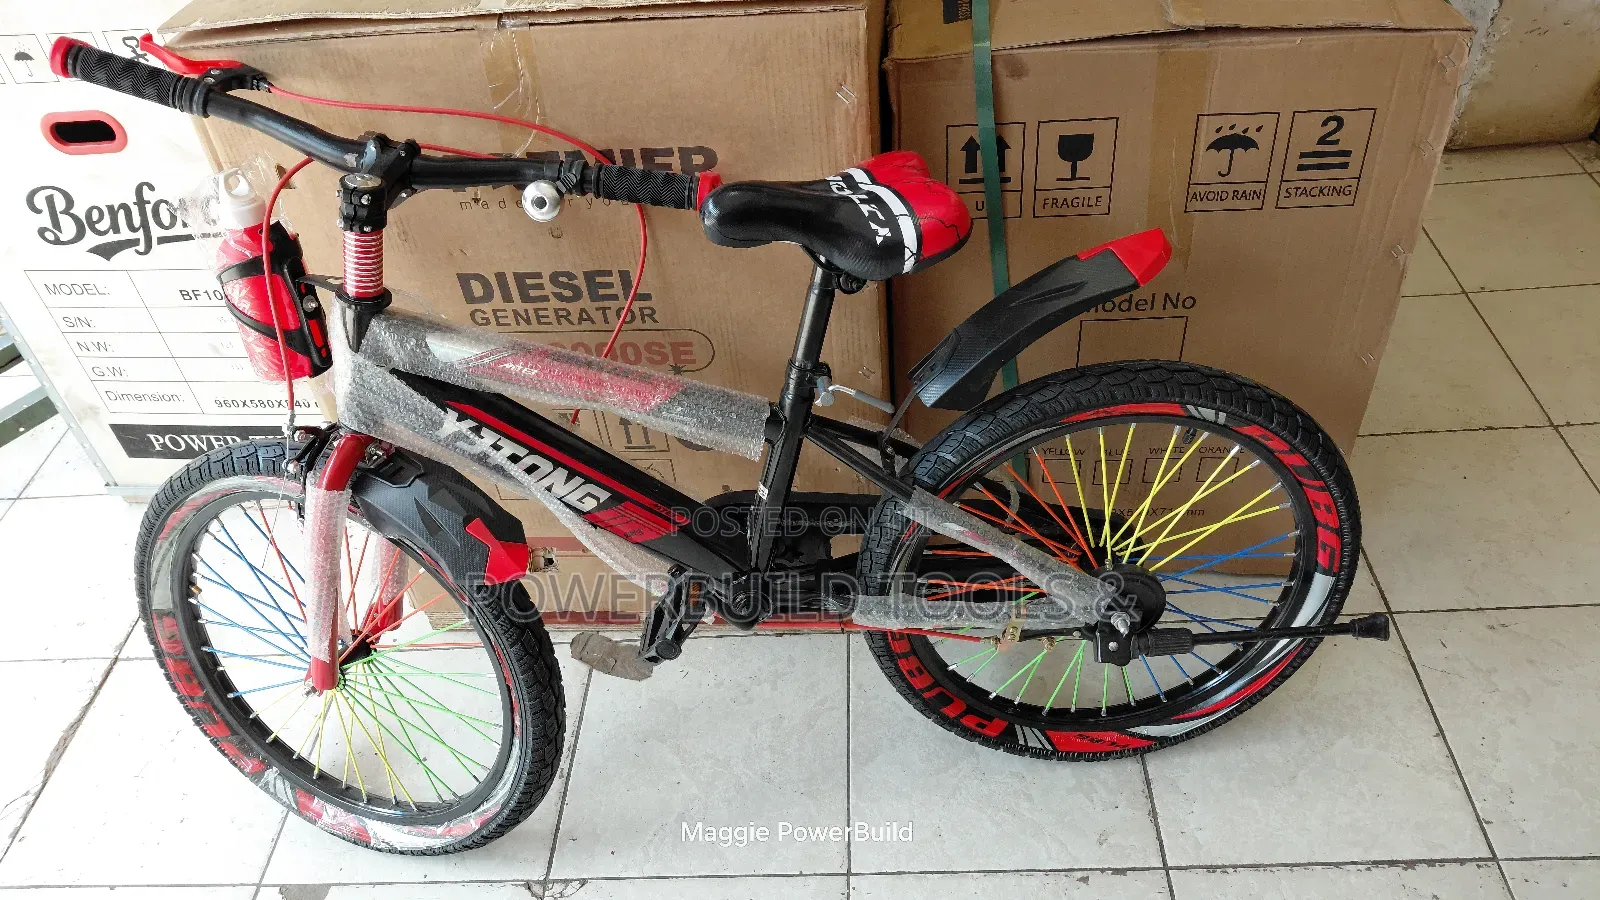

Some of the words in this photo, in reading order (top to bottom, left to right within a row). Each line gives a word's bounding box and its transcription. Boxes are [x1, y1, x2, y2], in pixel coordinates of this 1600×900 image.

[1316, 115, 1345, 145] 2
[1190, 190, 1229, 203] AVOID
[1231, 188, 1262, 201] RAIN
[1284, 185, 1353, 199] STACKING
[1042, 195, 1103, 210] FRAGILE
[44, 283, 111, 296] MODEL:
[456, 269, 653, 305] DIESEL
[1161, 291, 1197, 311] No
[62, 316, 96, 328] S/N:
[469, 306, 660, 327] GENERATOR
[91, 366, 129, 377] G.W:
[105, 390, 185, 403] Dimension:
[1149, 446, 1185, 455] WHTE
[1198, 445, 1245, 454] ORANE
